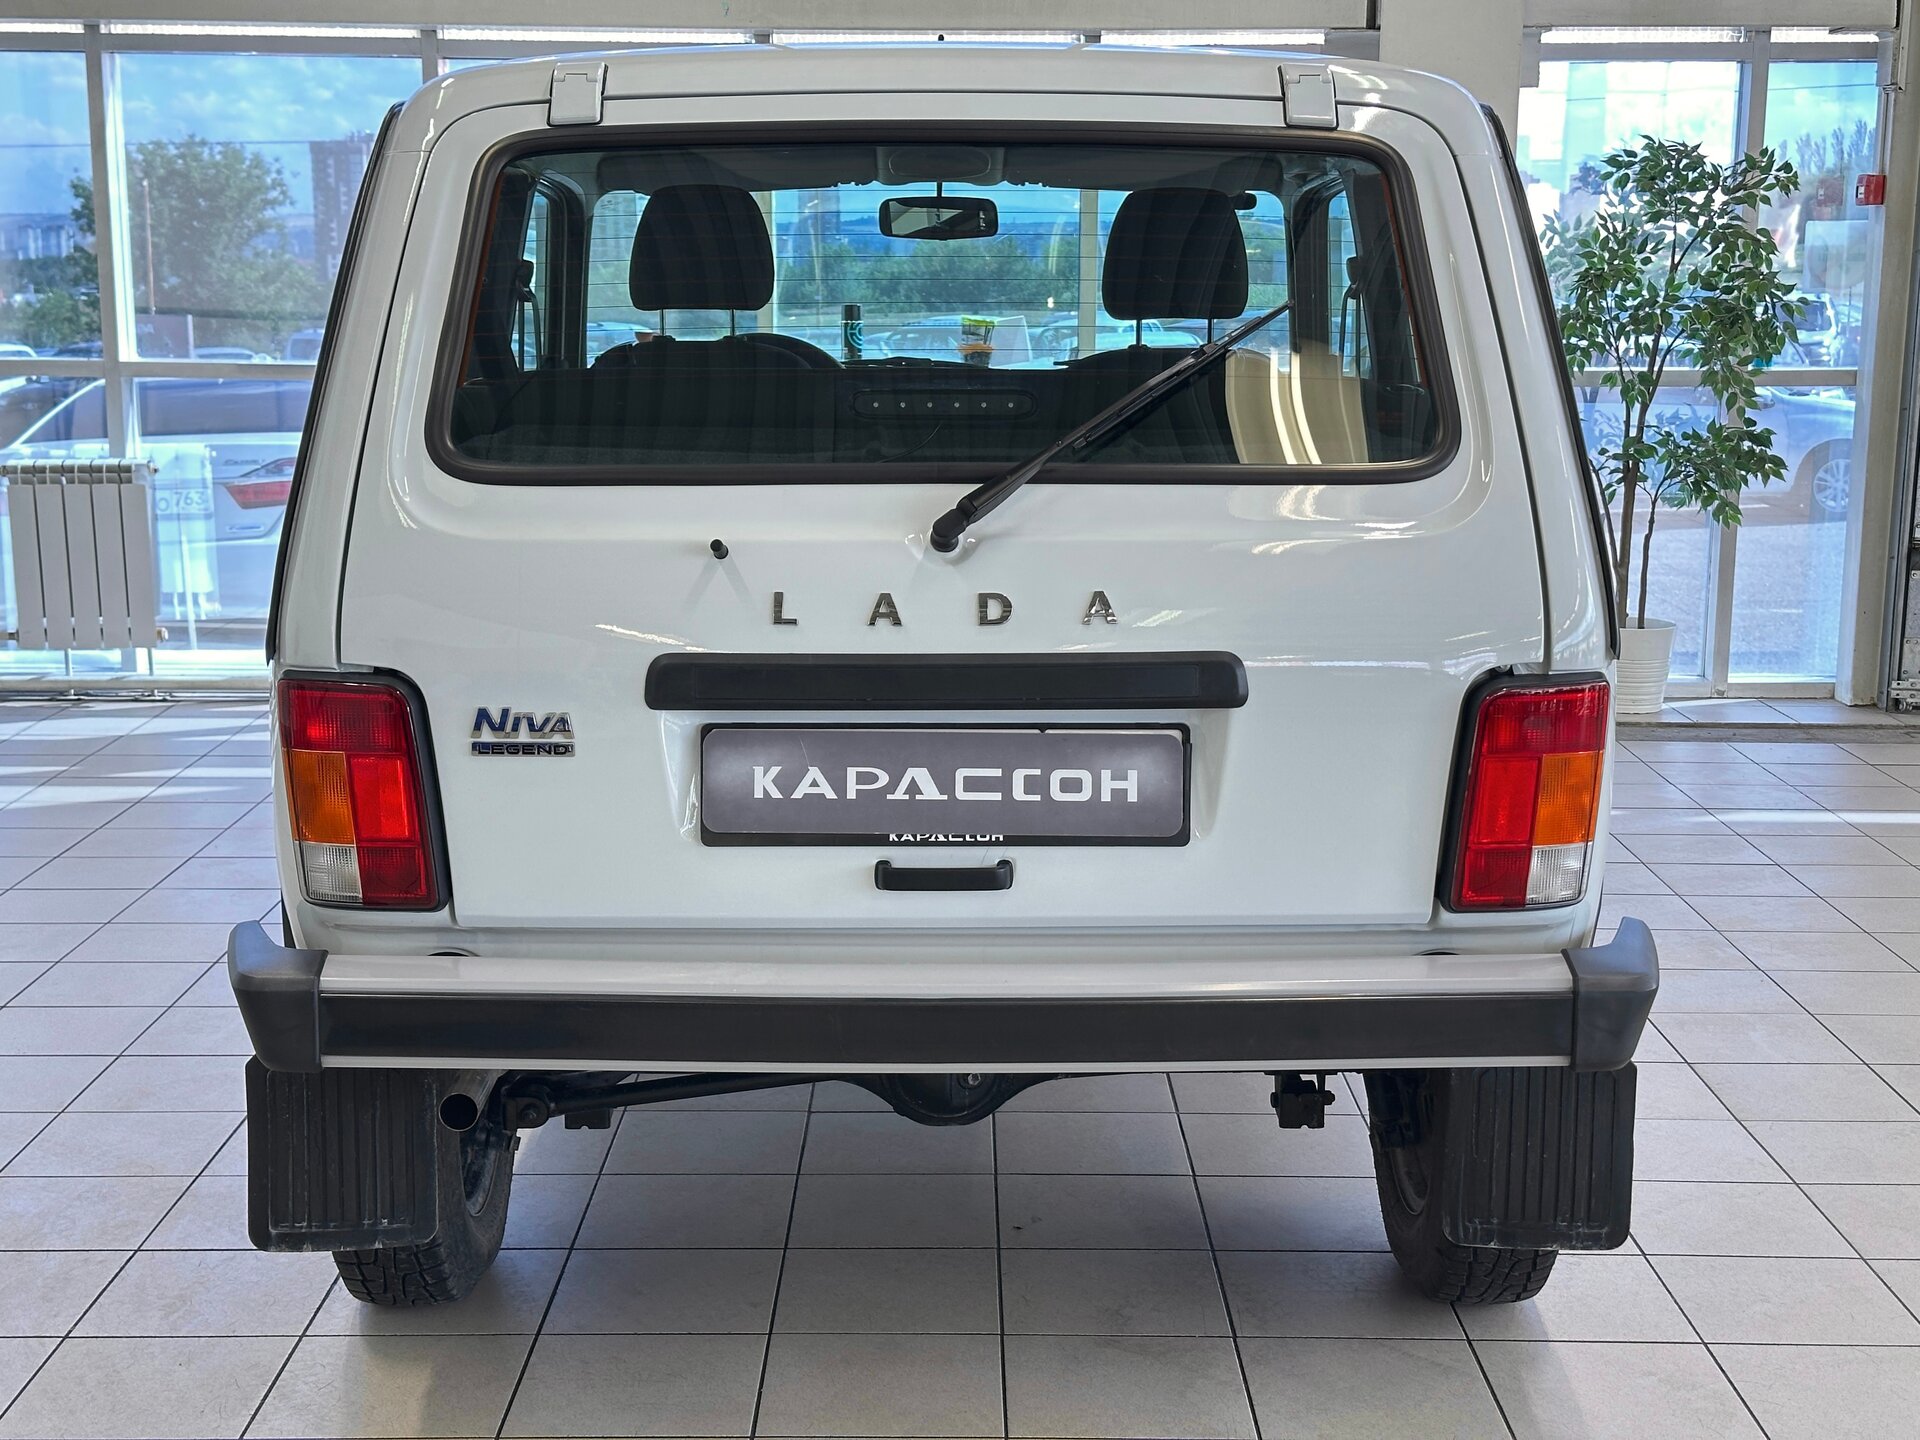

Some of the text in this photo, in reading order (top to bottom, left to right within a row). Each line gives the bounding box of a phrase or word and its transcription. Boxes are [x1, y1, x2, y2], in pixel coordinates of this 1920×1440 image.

[772, 591, 1117, 626] LADA
[471, 706, 575, 739] NIVA
[475, 743, 572, 756] LEGEND
